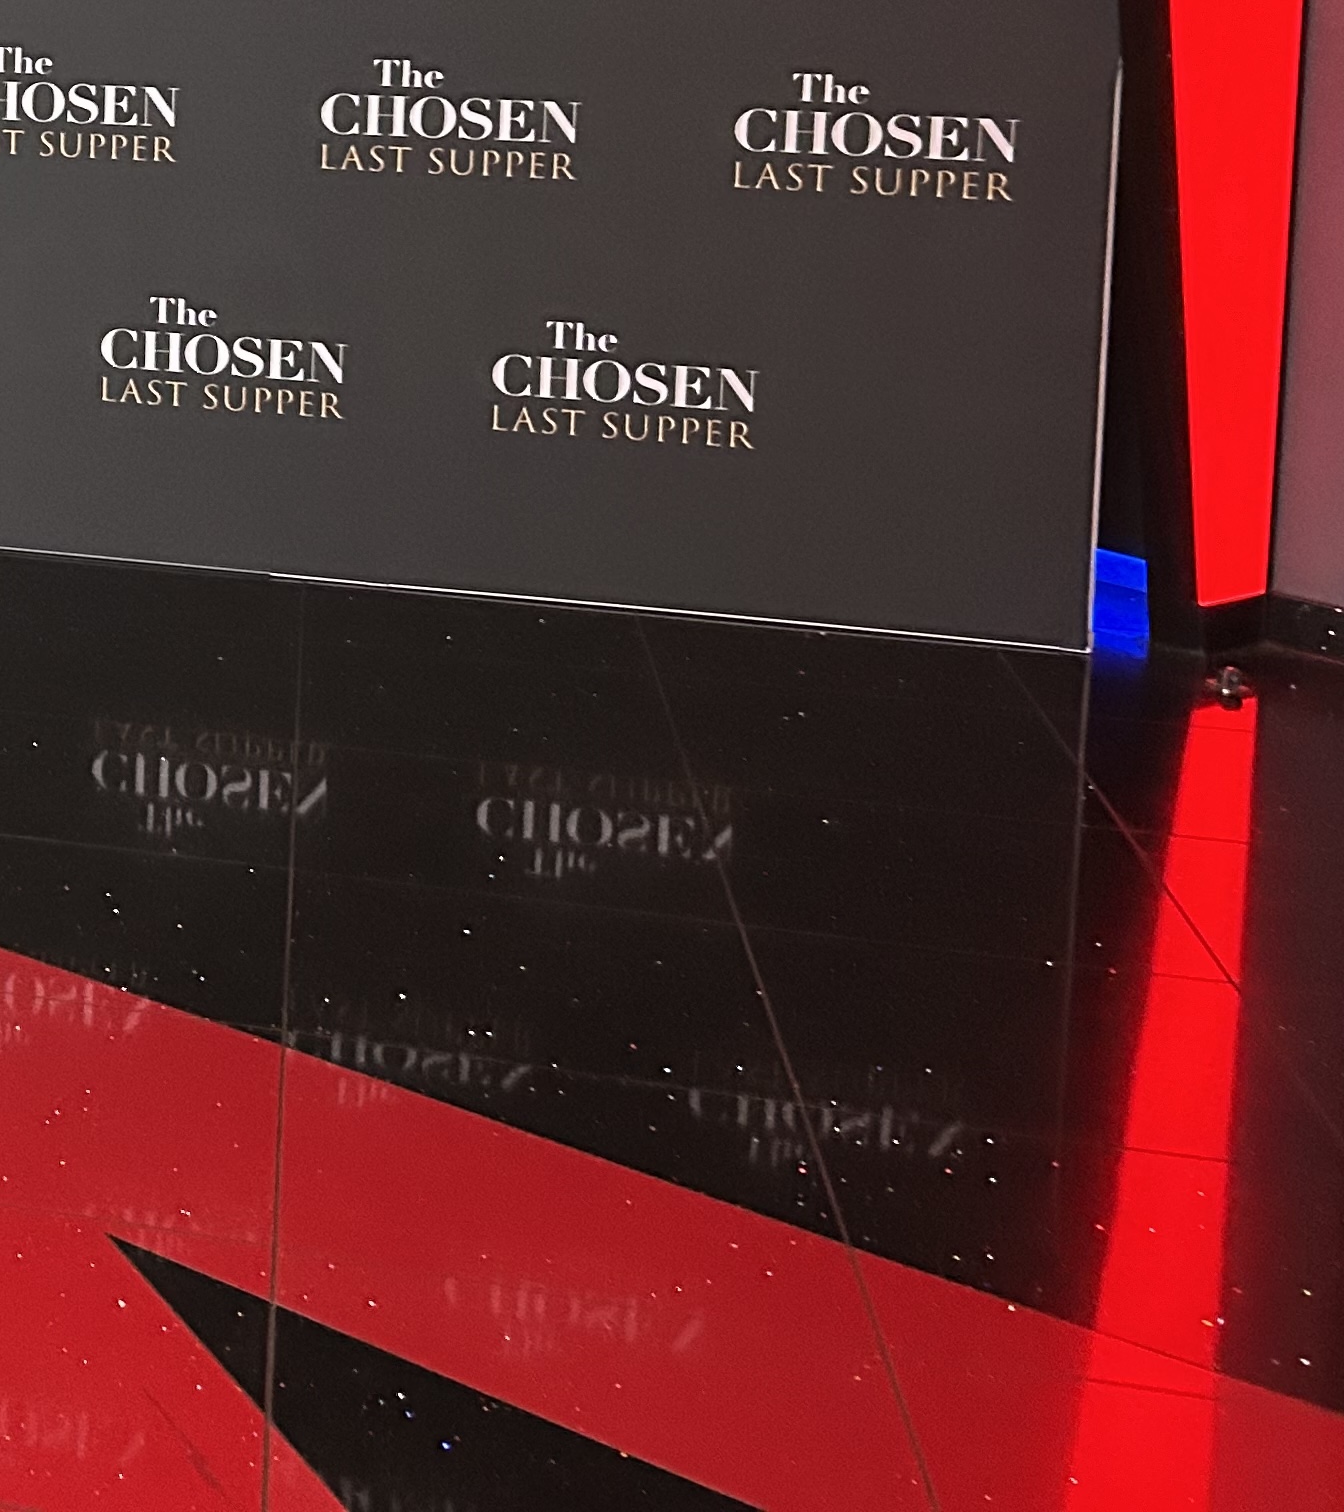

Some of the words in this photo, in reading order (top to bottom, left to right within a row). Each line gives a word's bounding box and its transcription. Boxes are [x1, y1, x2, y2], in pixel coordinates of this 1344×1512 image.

[374, 59, 444, 88] The
[793, 73, 869, 104] The
[321, 93, 581, 143] CHOSEN
[734, 108, 1019, 162] CHOSEN
[40, 131, 176, 162] SUPPER
[321, 144, 412, 172] LAST
[428, 148, 575, 180] SUPPER
[734, 162, 833, 192] LAST
[851, 166, 1012, 201] SUPPER
[150, 297, 217, 327] The
[101, 329, 347, 383] CHOSEN
[546, 321, 617, 352] The
[102, 377, 187, 406] LAST
[203, 384, 343, 419] SUPPER
[492, 354, 758, 412] CHOSEN
[493, 405, 585, 435] LAST
[602, 412, 753, 449] SUPPER
